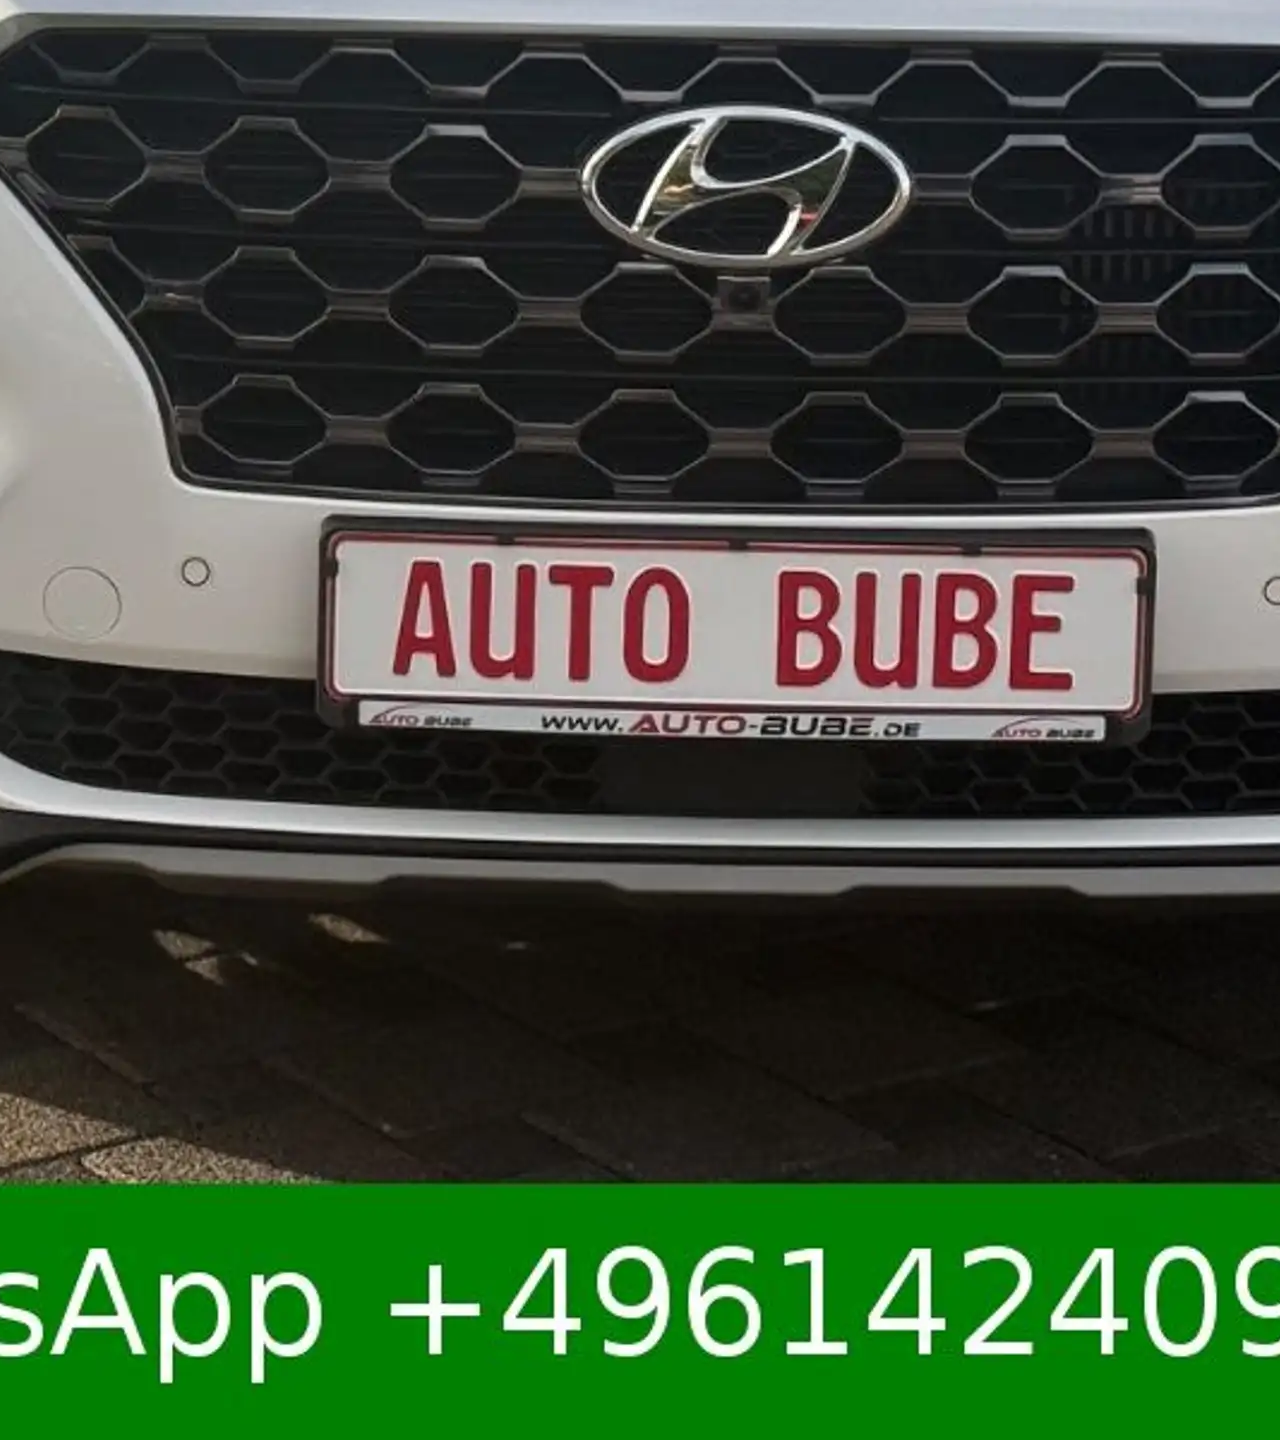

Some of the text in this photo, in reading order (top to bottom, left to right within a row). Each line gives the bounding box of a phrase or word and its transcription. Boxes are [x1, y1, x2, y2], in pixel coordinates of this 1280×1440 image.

[393, 560, 1075, 691] AUTO BUBE
[370, 713, 419, 726] AUTO
